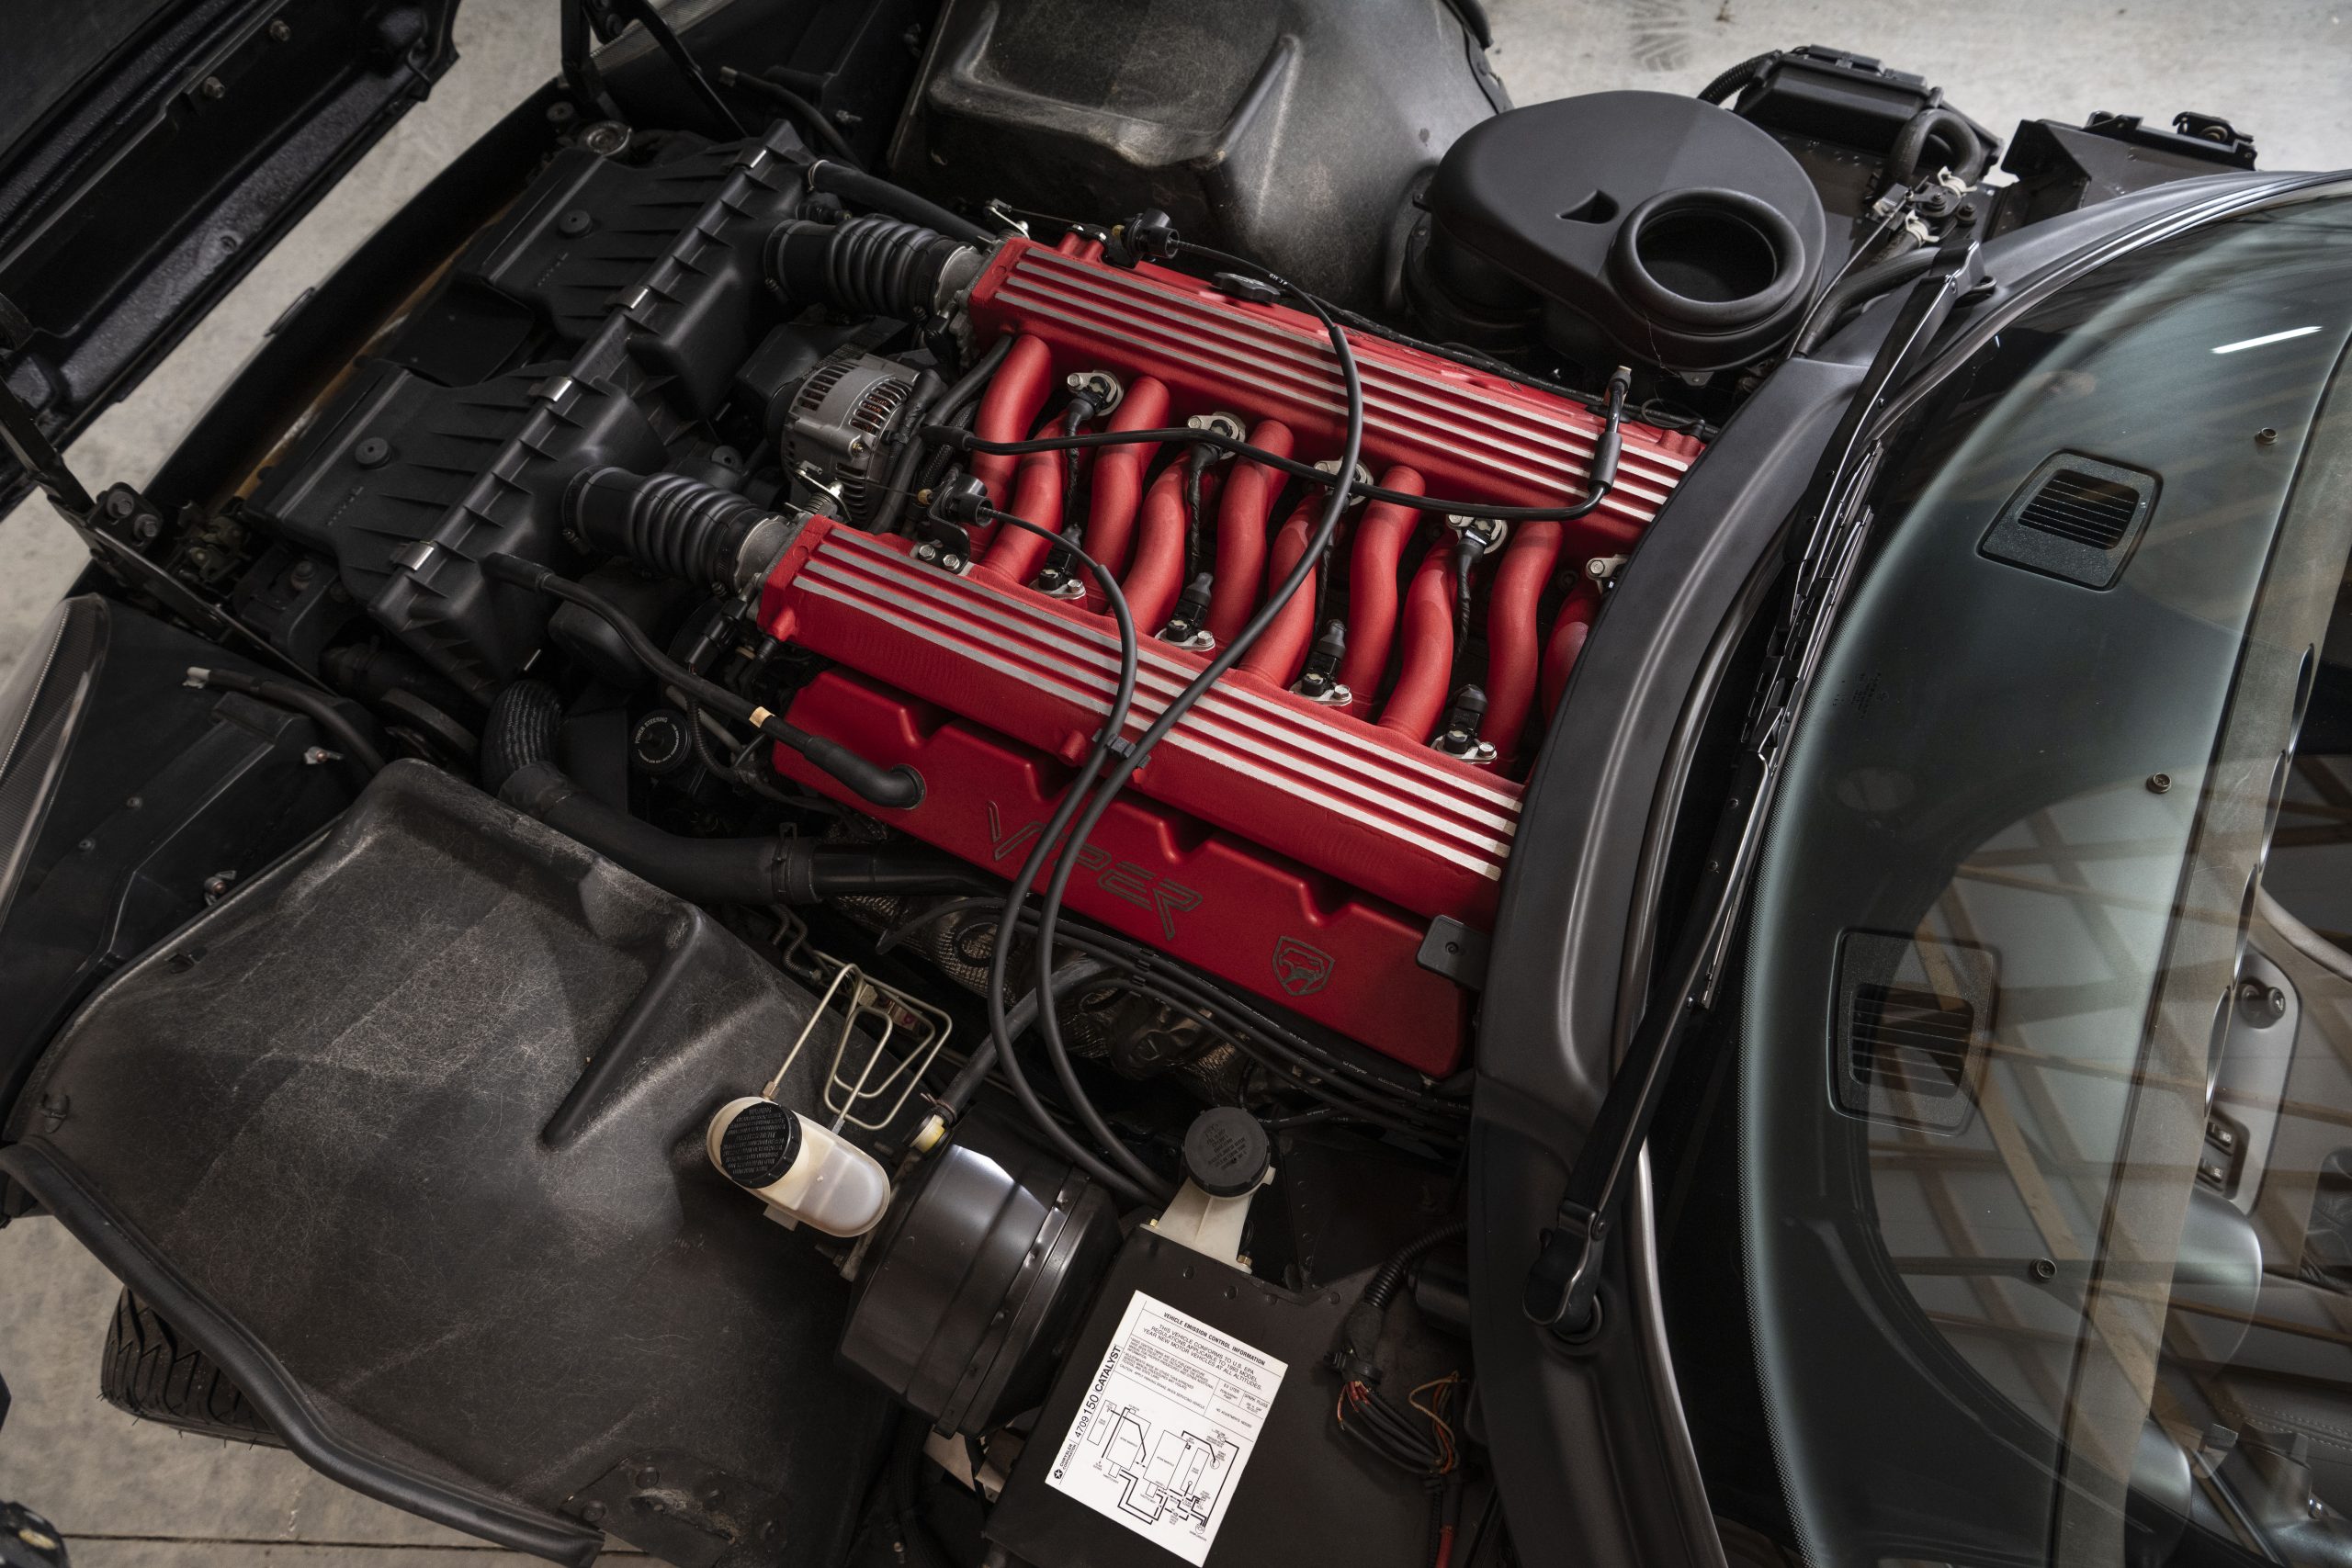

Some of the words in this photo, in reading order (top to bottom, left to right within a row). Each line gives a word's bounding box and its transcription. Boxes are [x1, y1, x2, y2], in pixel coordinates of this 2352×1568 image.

[635, 726, 645, 744] POWER
[644, 716, 668, 728] STEERING
[1143, 1328, 1158, 1338] YEAR
[1157, 1335, 1170, 1345] NEW
[1170, 1341, 1190, 1355] MOTOR
[1190, 1351, 1216, 1368] VEHICLES
[1223, 1368, 1233, 1376] ALL
[1150, 1326, 1186, 1347] REGULATIONS
[1186, 1344, 1217, 1362] APPLICABLE
[1238, 1370, 1259, 1382] MODEL
[1159, 1325, 1171, 1334] THIS
[1171, 1330, 1193, 1345] VEHICLE
[1193, 1341, 1224, 1359] CONFORMS
[1232, 1360, 1243, 1370] U.S.
[1243, 1366, 1255, 1375] EPA
[1163, 1312, 1183, 1325] VEHICLE
[1183, 1322, 1208, 1337] EMISSION
[1208, 1334, 1231, 1349] CONTROL
[1231, 1346, 1266, 1366] INFORMATION
[1094, 1346, 1122, 1393] CATALYST
[1072, 1415, 1090, 1438] 4709
[1082, 1393, 1100, 1416] 150
[1059, 1443, 1073, 1467] CHRYSLER
[1062, 1444, 1077, 1471] CORPORATION
